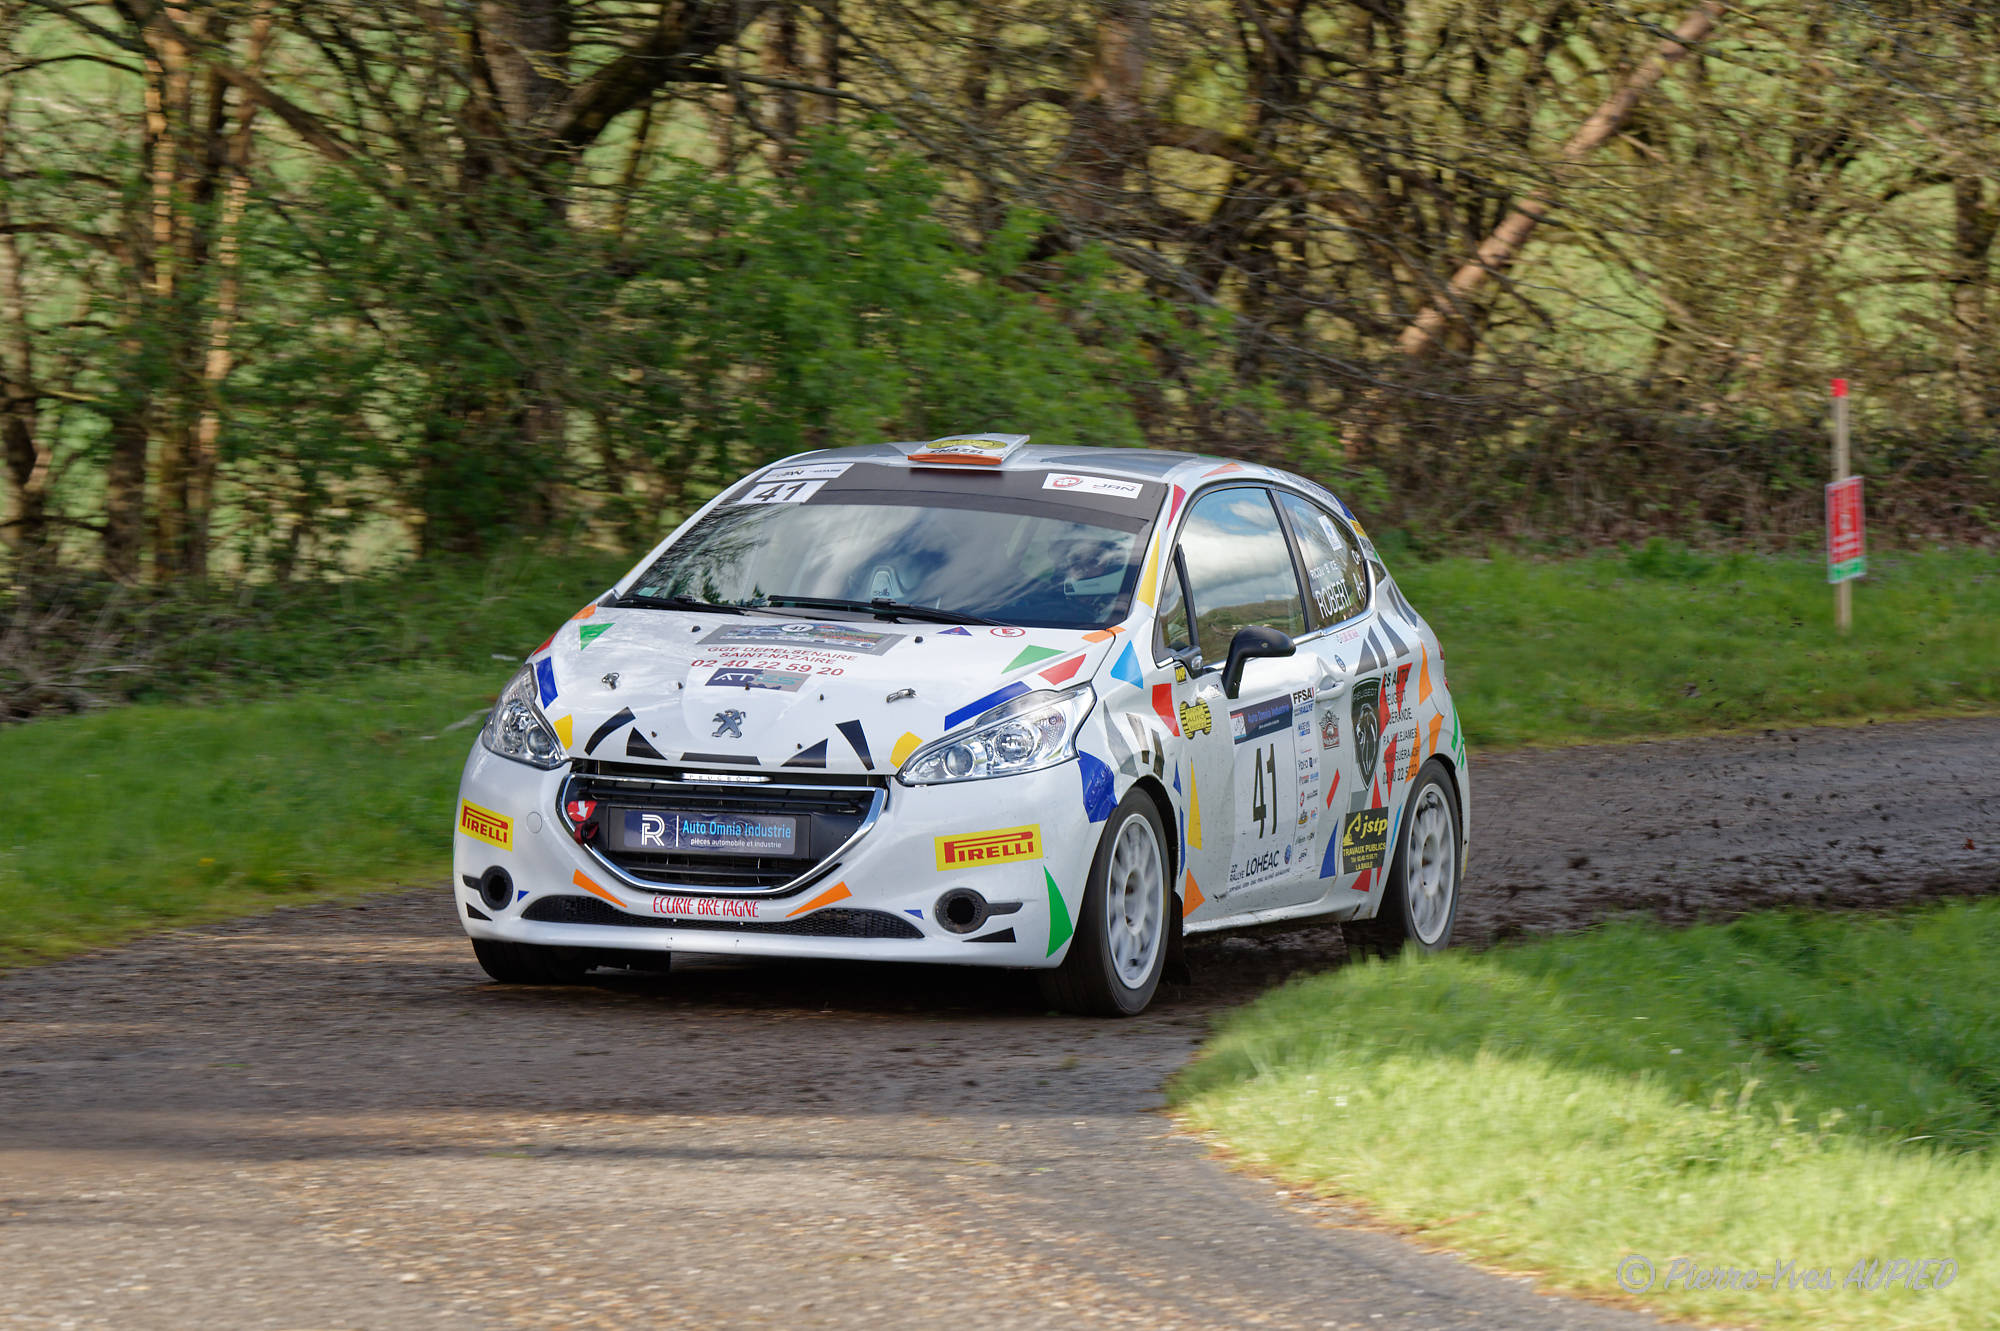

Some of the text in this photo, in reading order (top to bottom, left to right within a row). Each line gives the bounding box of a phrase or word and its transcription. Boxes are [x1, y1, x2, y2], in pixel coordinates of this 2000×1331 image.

[753, 482, 807, 502] 41
[1315, 579, 1352, 619] ROBERT
[691, 659, 844, 676] 02 40 22 59 20
[720, 652, 836, 664] SAINT-NAZAIRE
[1293, 689, 1313, 704] FFSA
[1252, 743, 1278, 839] 41
[462, 805, 508, 843] PIRELLI
[682, 820, 792, 839] Auto Omnia Industrie
[1360, 815, 1388, 839] jstp
[711, 839, 746, 848] automobile
[943, 831, 1034, 864] PIRELLI
[1343, 841, 1386, 857] TRAVAUX PUBLICS
[1246, 850, 1279, 877] LOHÉAC
[697, 898, 760, 918] BRETAGNE
